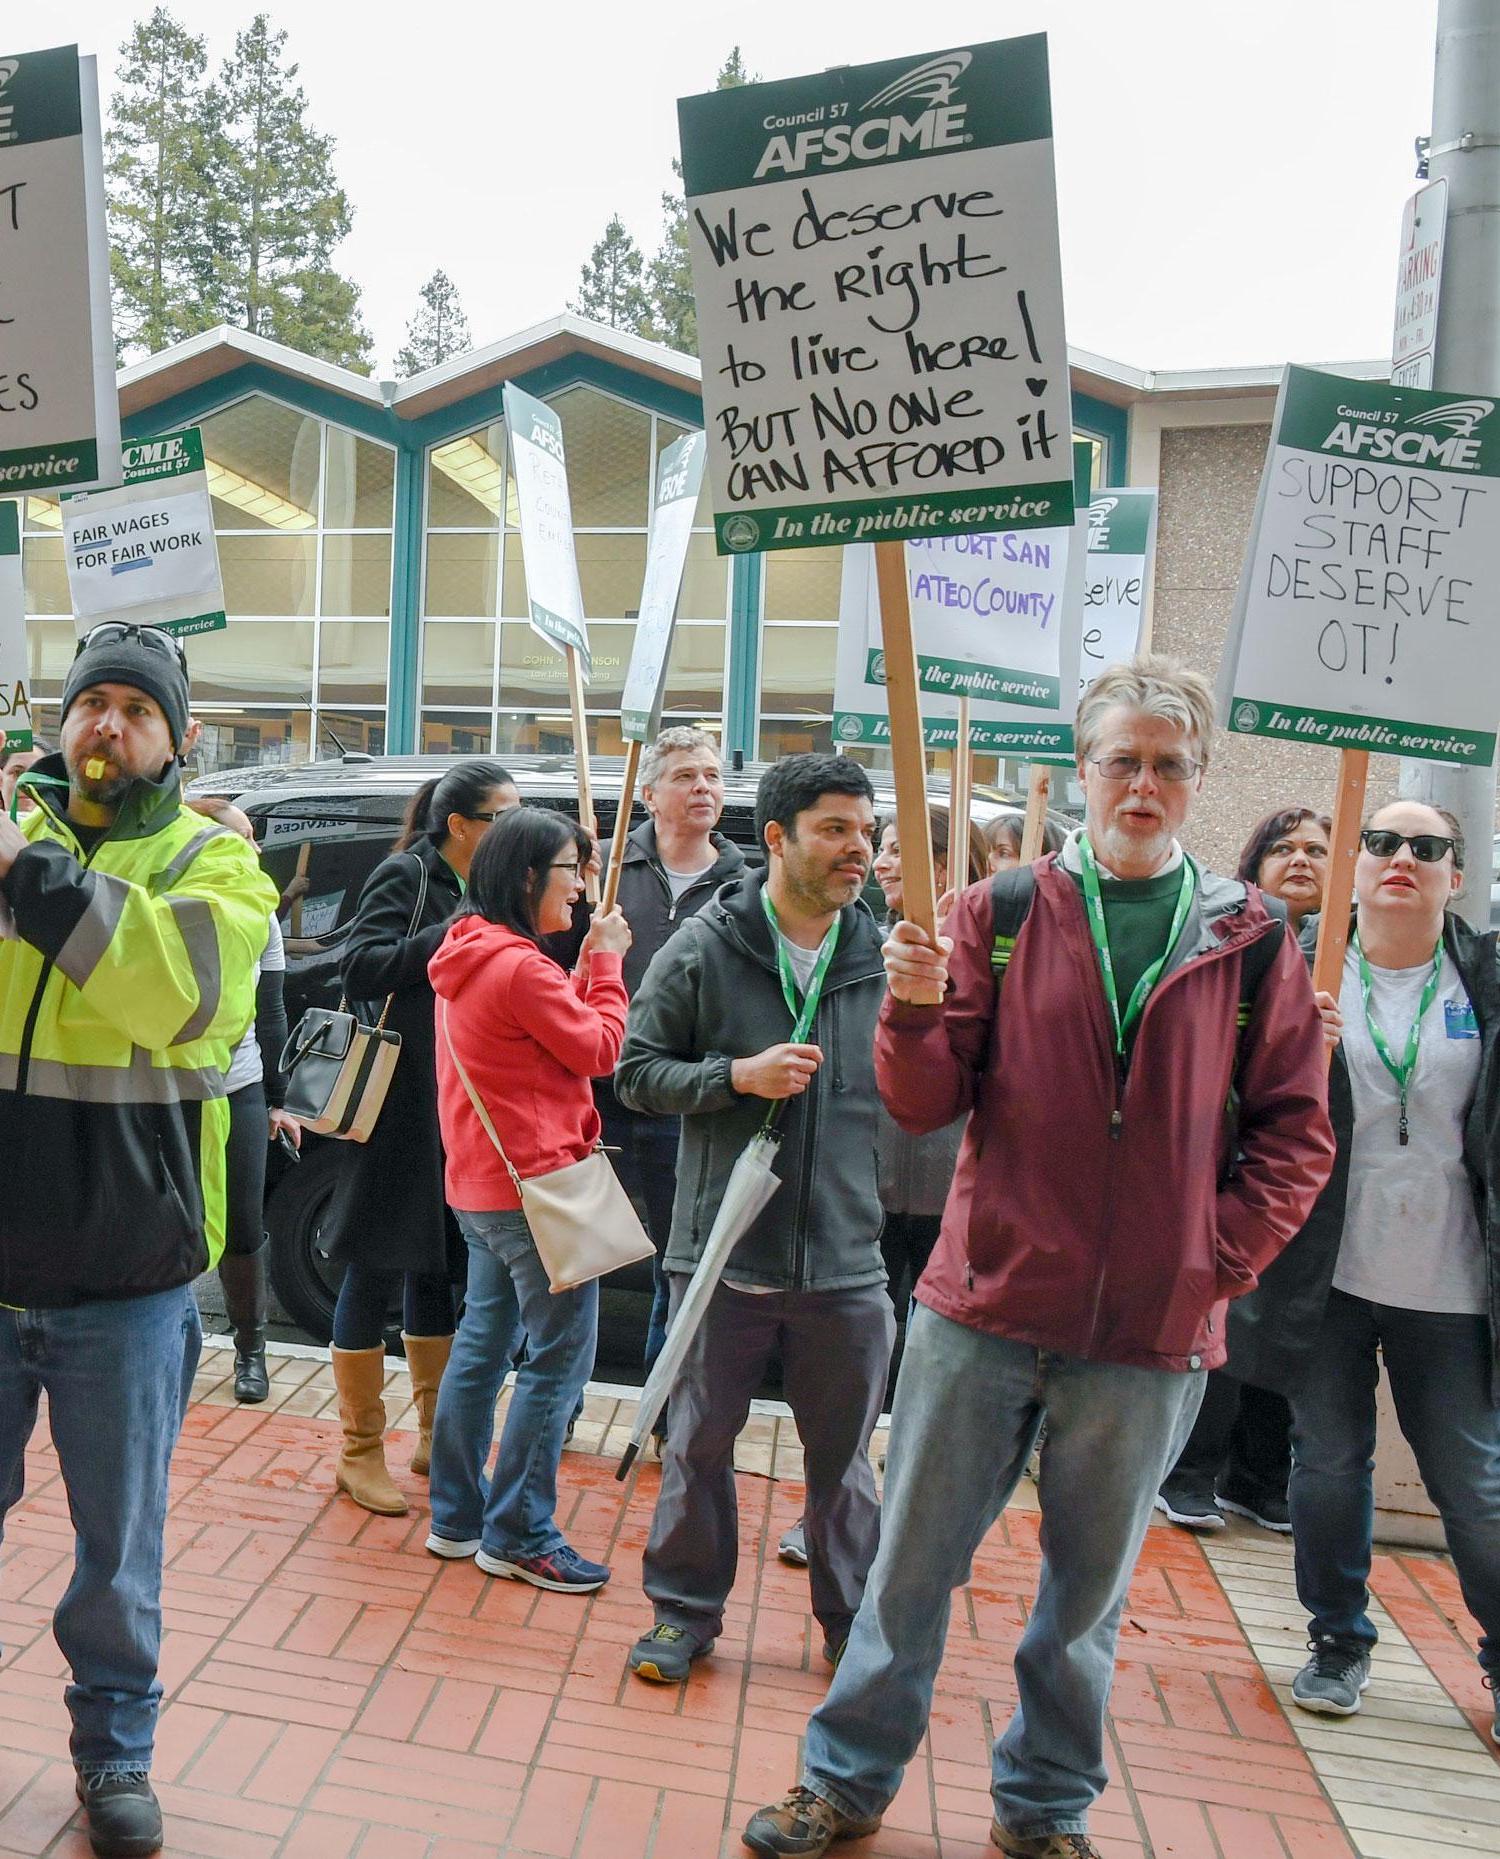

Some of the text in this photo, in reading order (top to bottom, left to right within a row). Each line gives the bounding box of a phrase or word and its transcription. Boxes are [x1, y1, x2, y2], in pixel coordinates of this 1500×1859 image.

[762, 102, 850, 131] Council 57
[752, 104, 968, 179] AFSCME
[694, 187, 1005, 268] We deserve
[727, 278, 815, 324] the
[718, 343, 766, 388] to
[790, 333, 880, 381] live
[716, 405, 800, 461] BUT
[1336, 404, 1400, 424] Council 57
[122, 456, 190, 480] Council 57
[727, 452, 811, 502] CAN
[822, 435, 1006, 494] AFFORD
[1320, 422, 1482, 470] AFSCME
[1278, 458, 1487, 528] SUPPORT
[73, 512, 170, 544] FAIR WAGES
[772, 496, 1051, 540] In the public service
[76, 532, 202, 570] FOR FAIR WORK
[1002, 534, 1050, 570] SAN
[1294, 514, 1451, 570] STAFF
[972, 576, 1056, 630] COUNTY
[1268, 553, 1473, 625] DESERVE
[177, 620, 216, 634] service
[523, 656, 554, 666] COHN
[1318, 618, 1400, 685] OT!
[924, 666, 950, 685] the
[950, 670, 998, 694] public
[1001, 679, 1050, 700] service
[930, 726, 990, 748] pulic
[993, 728, 1061, 746] service
[1266, 711, 1478, 756] In the public service
